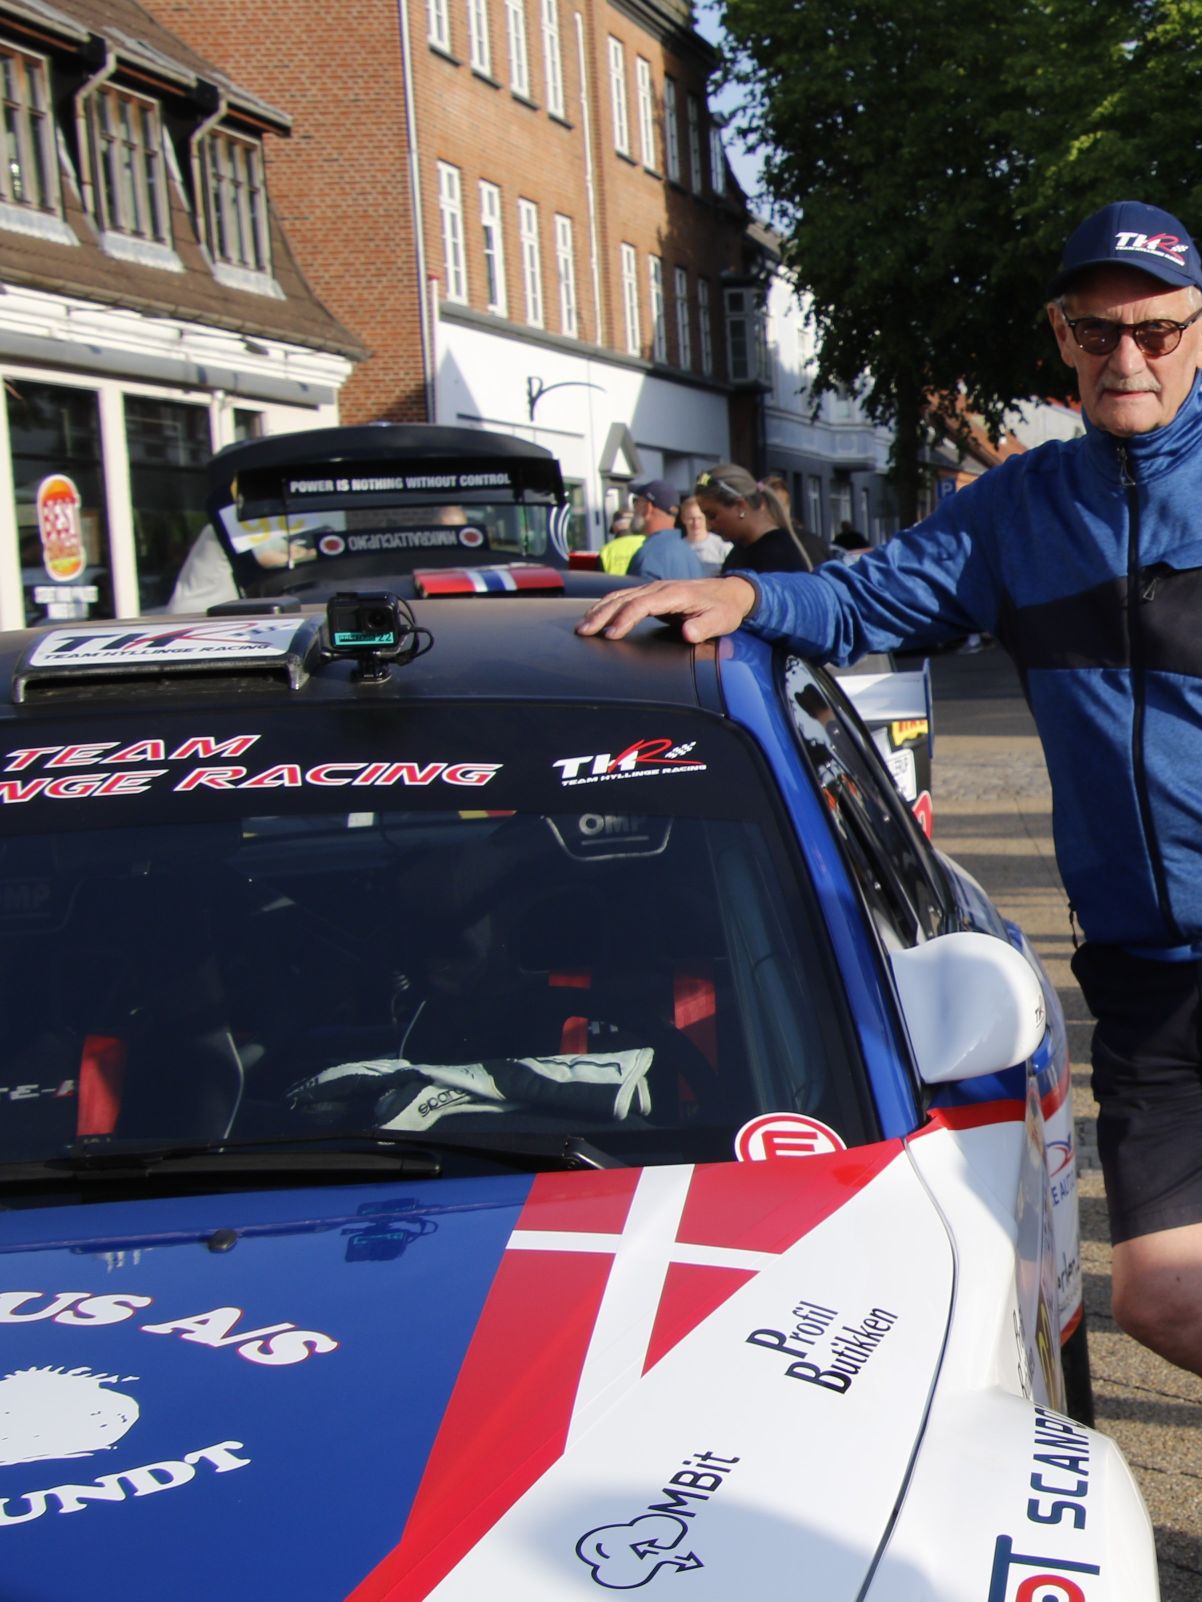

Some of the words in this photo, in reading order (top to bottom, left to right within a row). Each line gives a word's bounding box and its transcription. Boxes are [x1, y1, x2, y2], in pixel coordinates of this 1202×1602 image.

[290, 480, 335, 493] POWER
[336, 479, 350, 491] IS
[351, 477, 404, 491] NOTHING
[405, 475, 457, 489] WITHOUT
[459, 473, 511, 487] CONTROL
[44, 651, 98, 661] TEAM
[103, 647, 197, 657] HYLLINGE
[199, 643, 273, 652] RACING
[3, 735, 262, 772] TEAM
[173, 760, 504, 792] RACING
[562, 776, 598, 787] TEAM
[600, 769, 660, 782] HYLLINGE
[661, 764, 707, 774] RACING
[141, 1307, 339, 1365] A/S
[744, 1300, 839, 1360] Profil
[784, 1306, 899, 1395] Butikken
